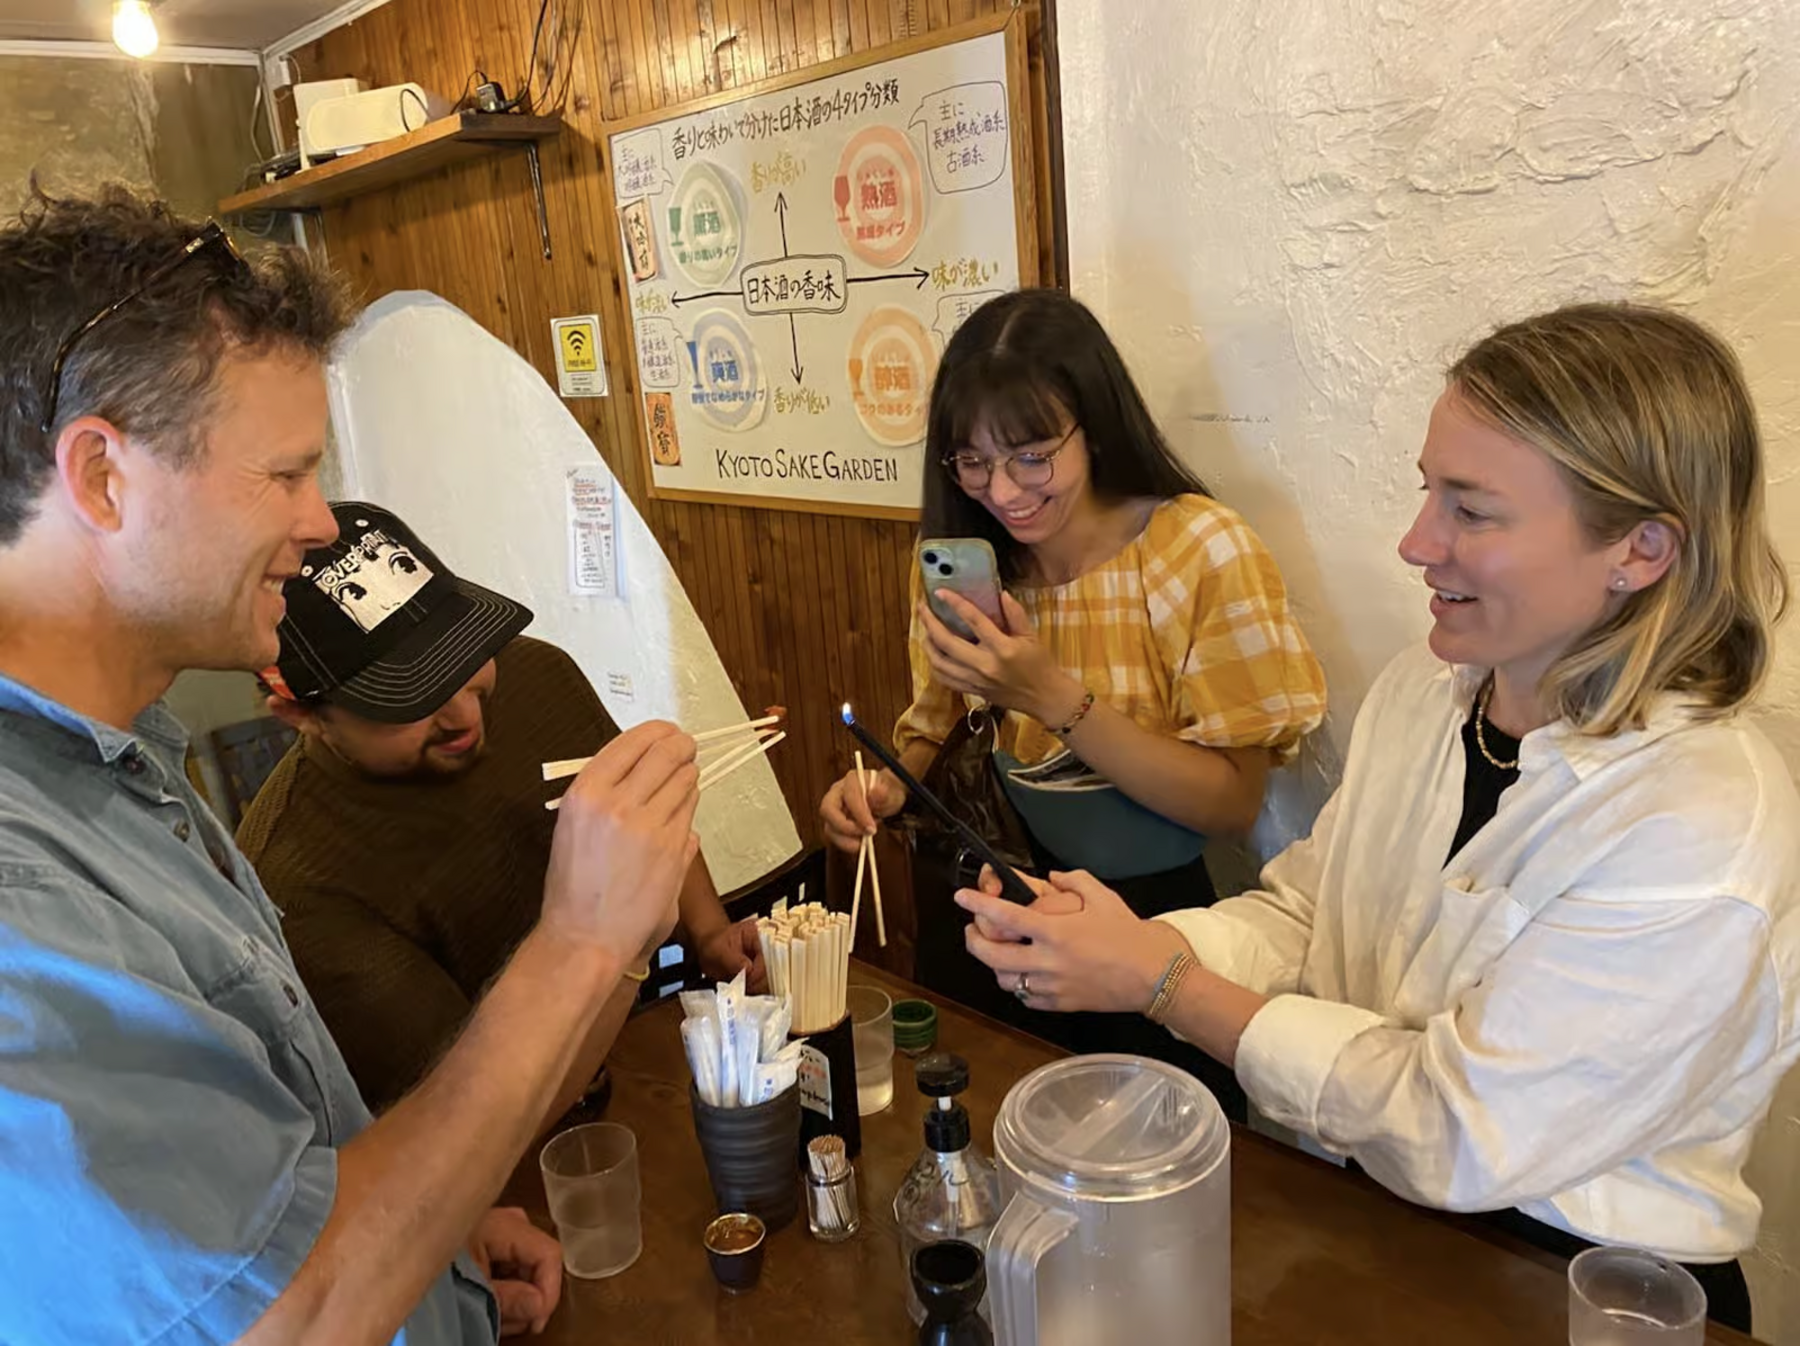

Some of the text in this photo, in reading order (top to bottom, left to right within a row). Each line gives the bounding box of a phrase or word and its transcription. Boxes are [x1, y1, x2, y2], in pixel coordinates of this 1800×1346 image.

[938, 101, 964, 121] 主に
[747, 269, 841, 304] 日本酒の香味
[859, 402, 923, 417] コクのあるタイ
[715, 448, 898, 482] KYOTO SAKE GARDEN
